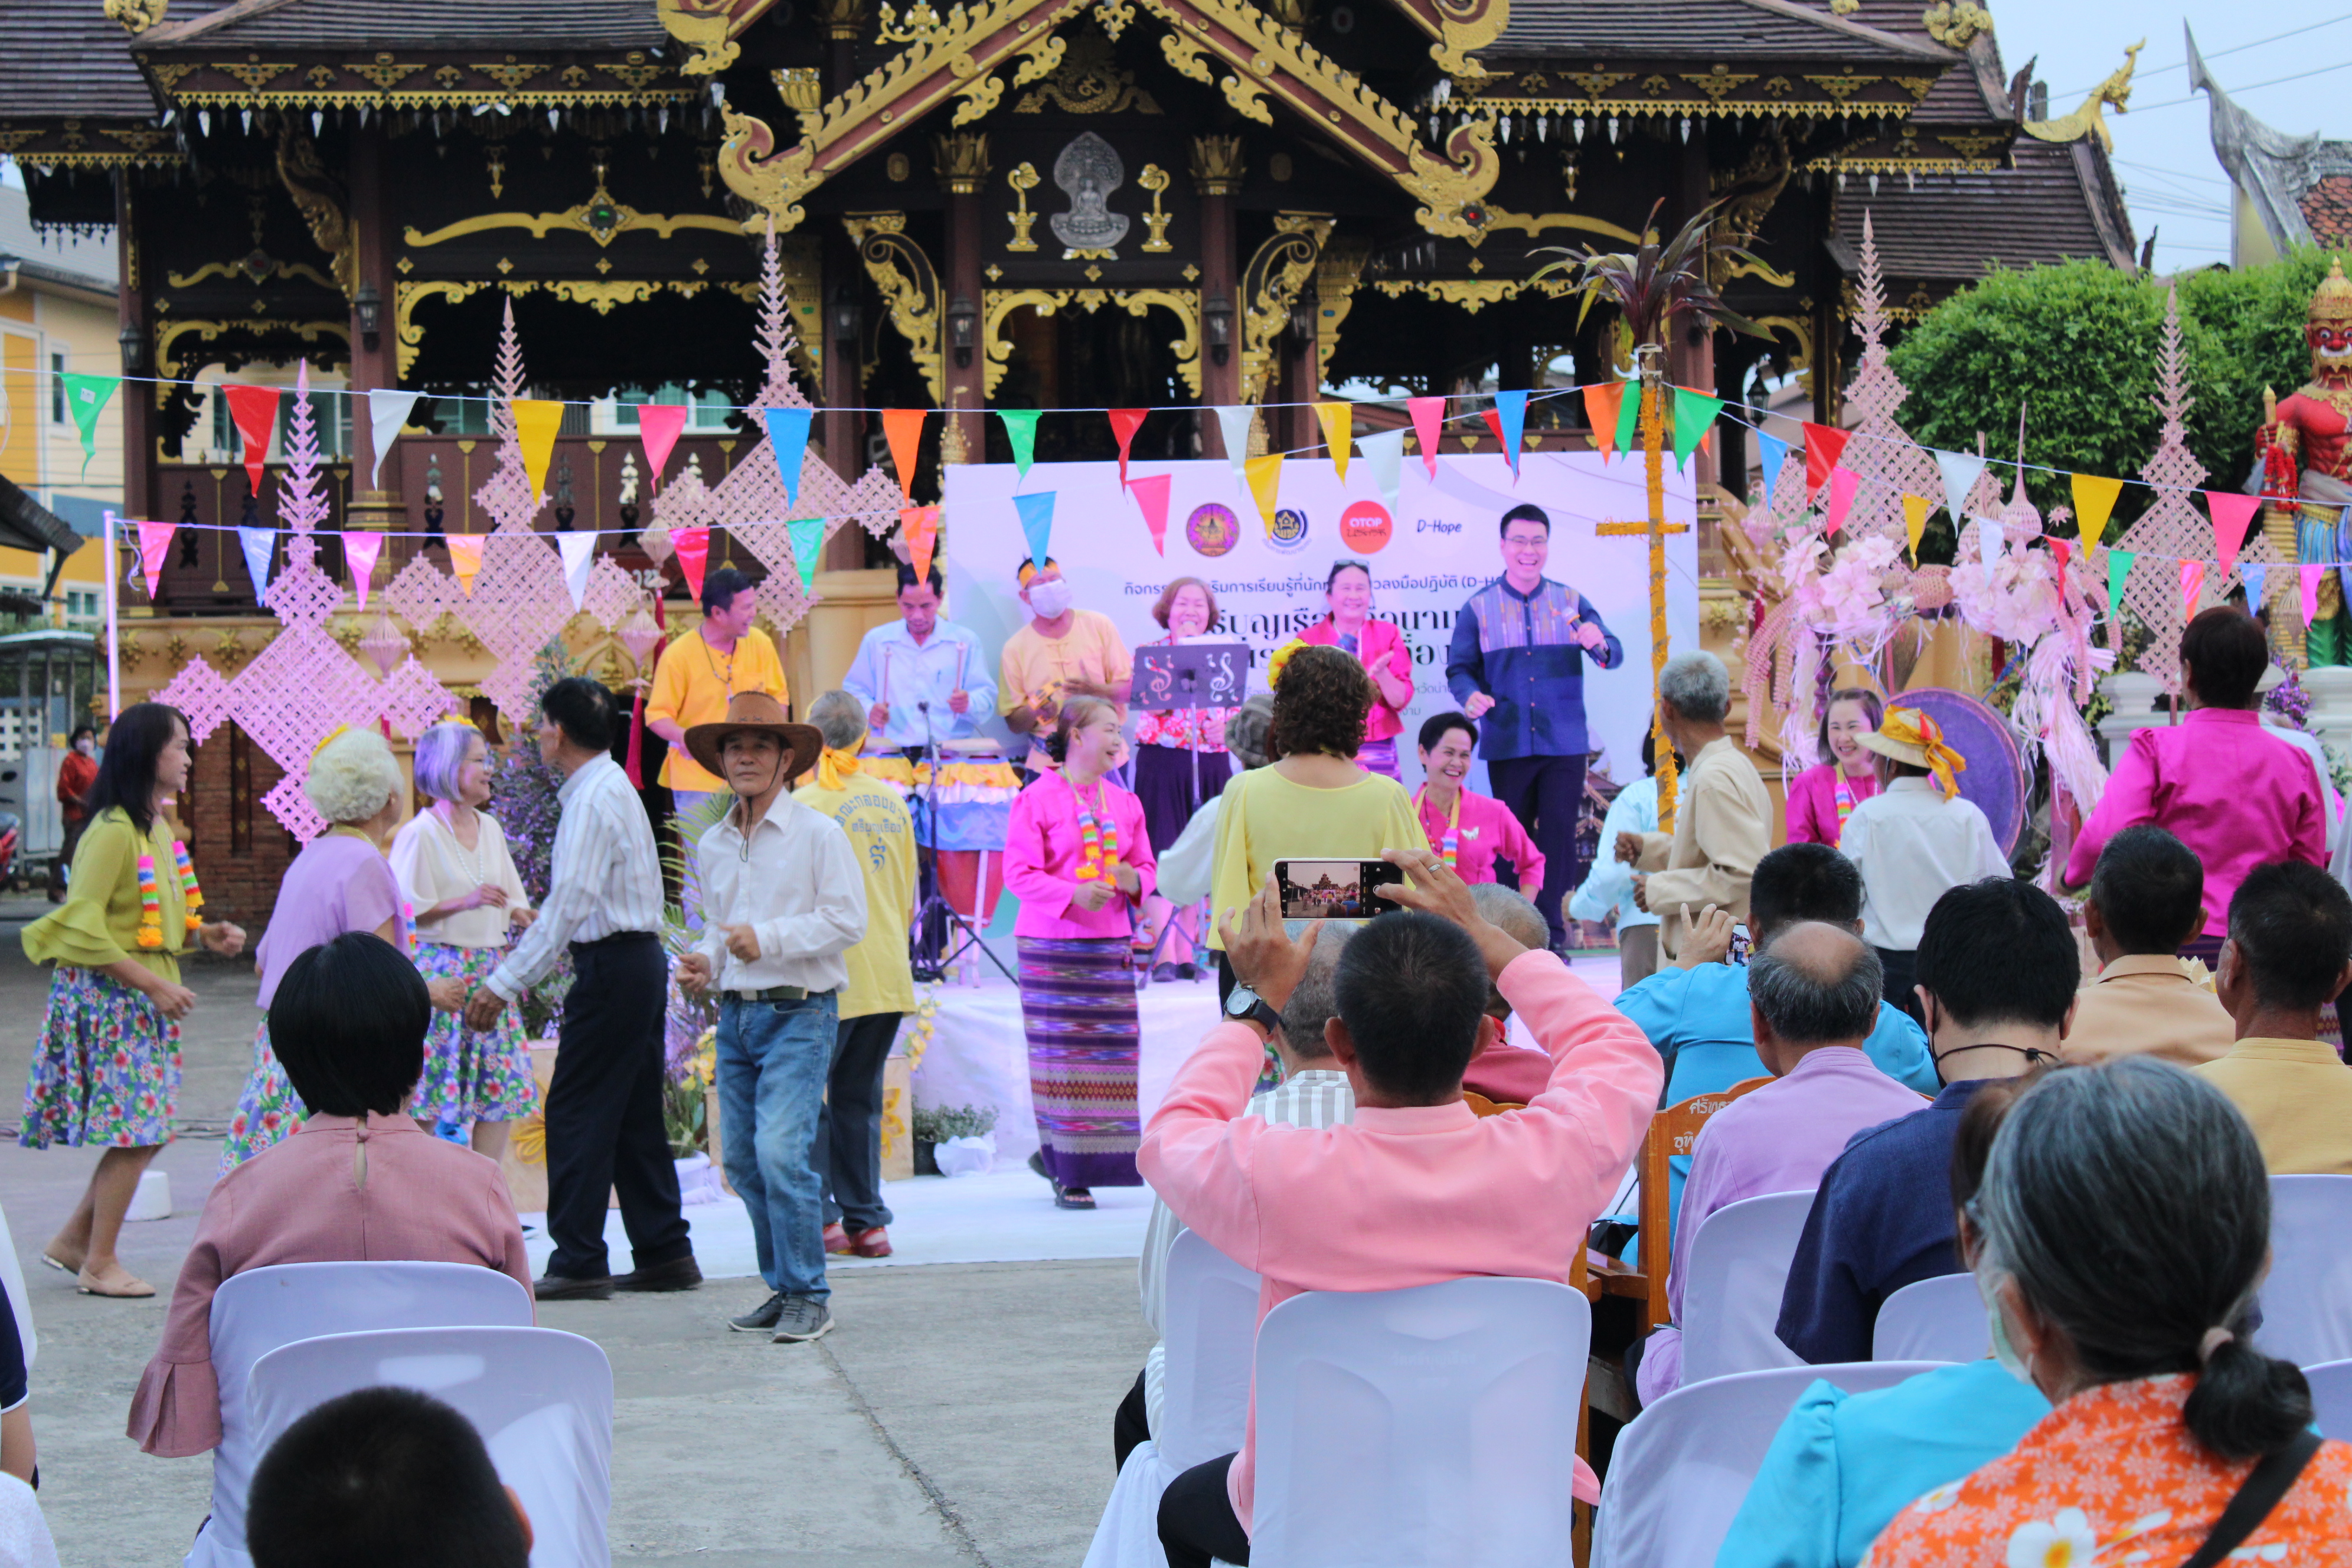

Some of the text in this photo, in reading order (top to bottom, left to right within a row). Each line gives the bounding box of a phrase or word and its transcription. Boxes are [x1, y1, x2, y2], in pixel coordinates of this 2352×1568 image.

[1349, 517, 1383, 527] OTOP
[1417, 520, 1462, 535] D-Hope
[1689, 1097, 1732, 1115] ศรัทธ
[1674, 1131, 1696, 1155] อุทิ
